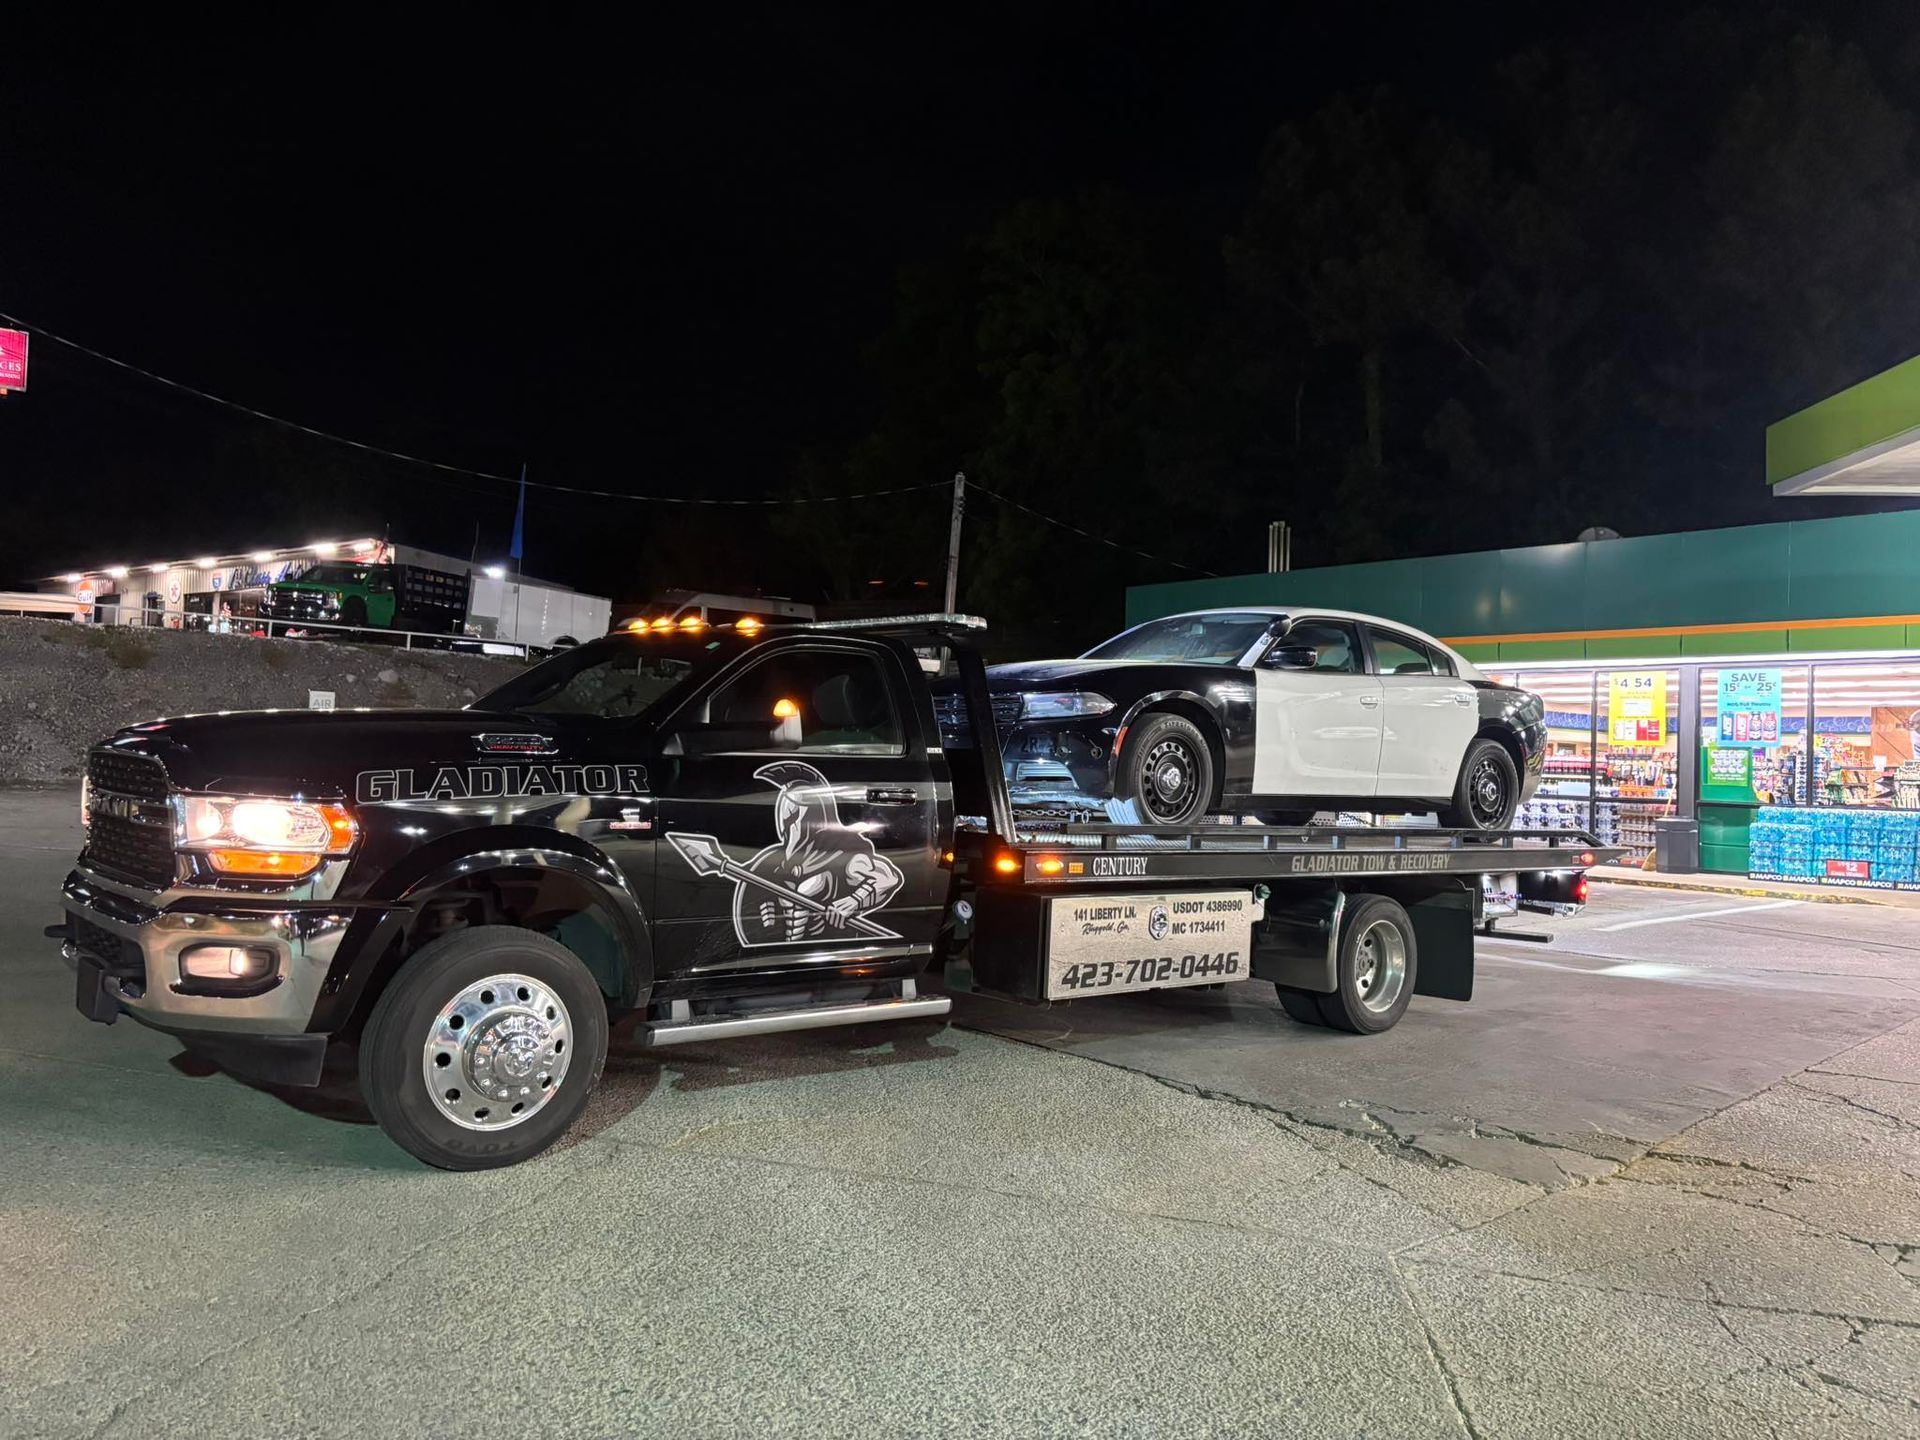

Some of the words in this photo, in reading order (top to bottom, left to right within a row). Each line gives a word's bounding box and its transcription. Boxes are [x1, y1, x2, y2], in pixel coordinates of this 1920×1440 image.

[78, 590, 93, 602] Gulf
[1731, 673, 1767, 682] SAVE
[312, 698, 332, 709] AIR
[355, 765, 650, 804] GLADIATOR
[1093, 856, 1148, 876] CENTURY
[1291, 855, 1359, 872] GLADIATOR
[1362, 855, 1387, 871] TOW
[1388, 855, 1396, 870] &
[1400, 854, 1451, 870] RECOVERY
[1756, 873, 1782, 881] MAPCO
[1787, 876, 1817, 884] MAPCO
[1827, 878, 1856, 886] MAPCO
[1862, 880, 1892, 888] MAPCO
[1074, 908, 1088, 922] 141
[1089, 906, 1123, 921] LIBERTY
[1125, 905, 1137, 919] LN.
[1173, 901, 1204, 914] USDOT
[1206, 900, 1242, 913] 4386990
[1172, 922, 1187, 935] MC
[1189, 920, 1225, 934] 1734411
[1061, 952, 1239, 990] 423-702-0446
